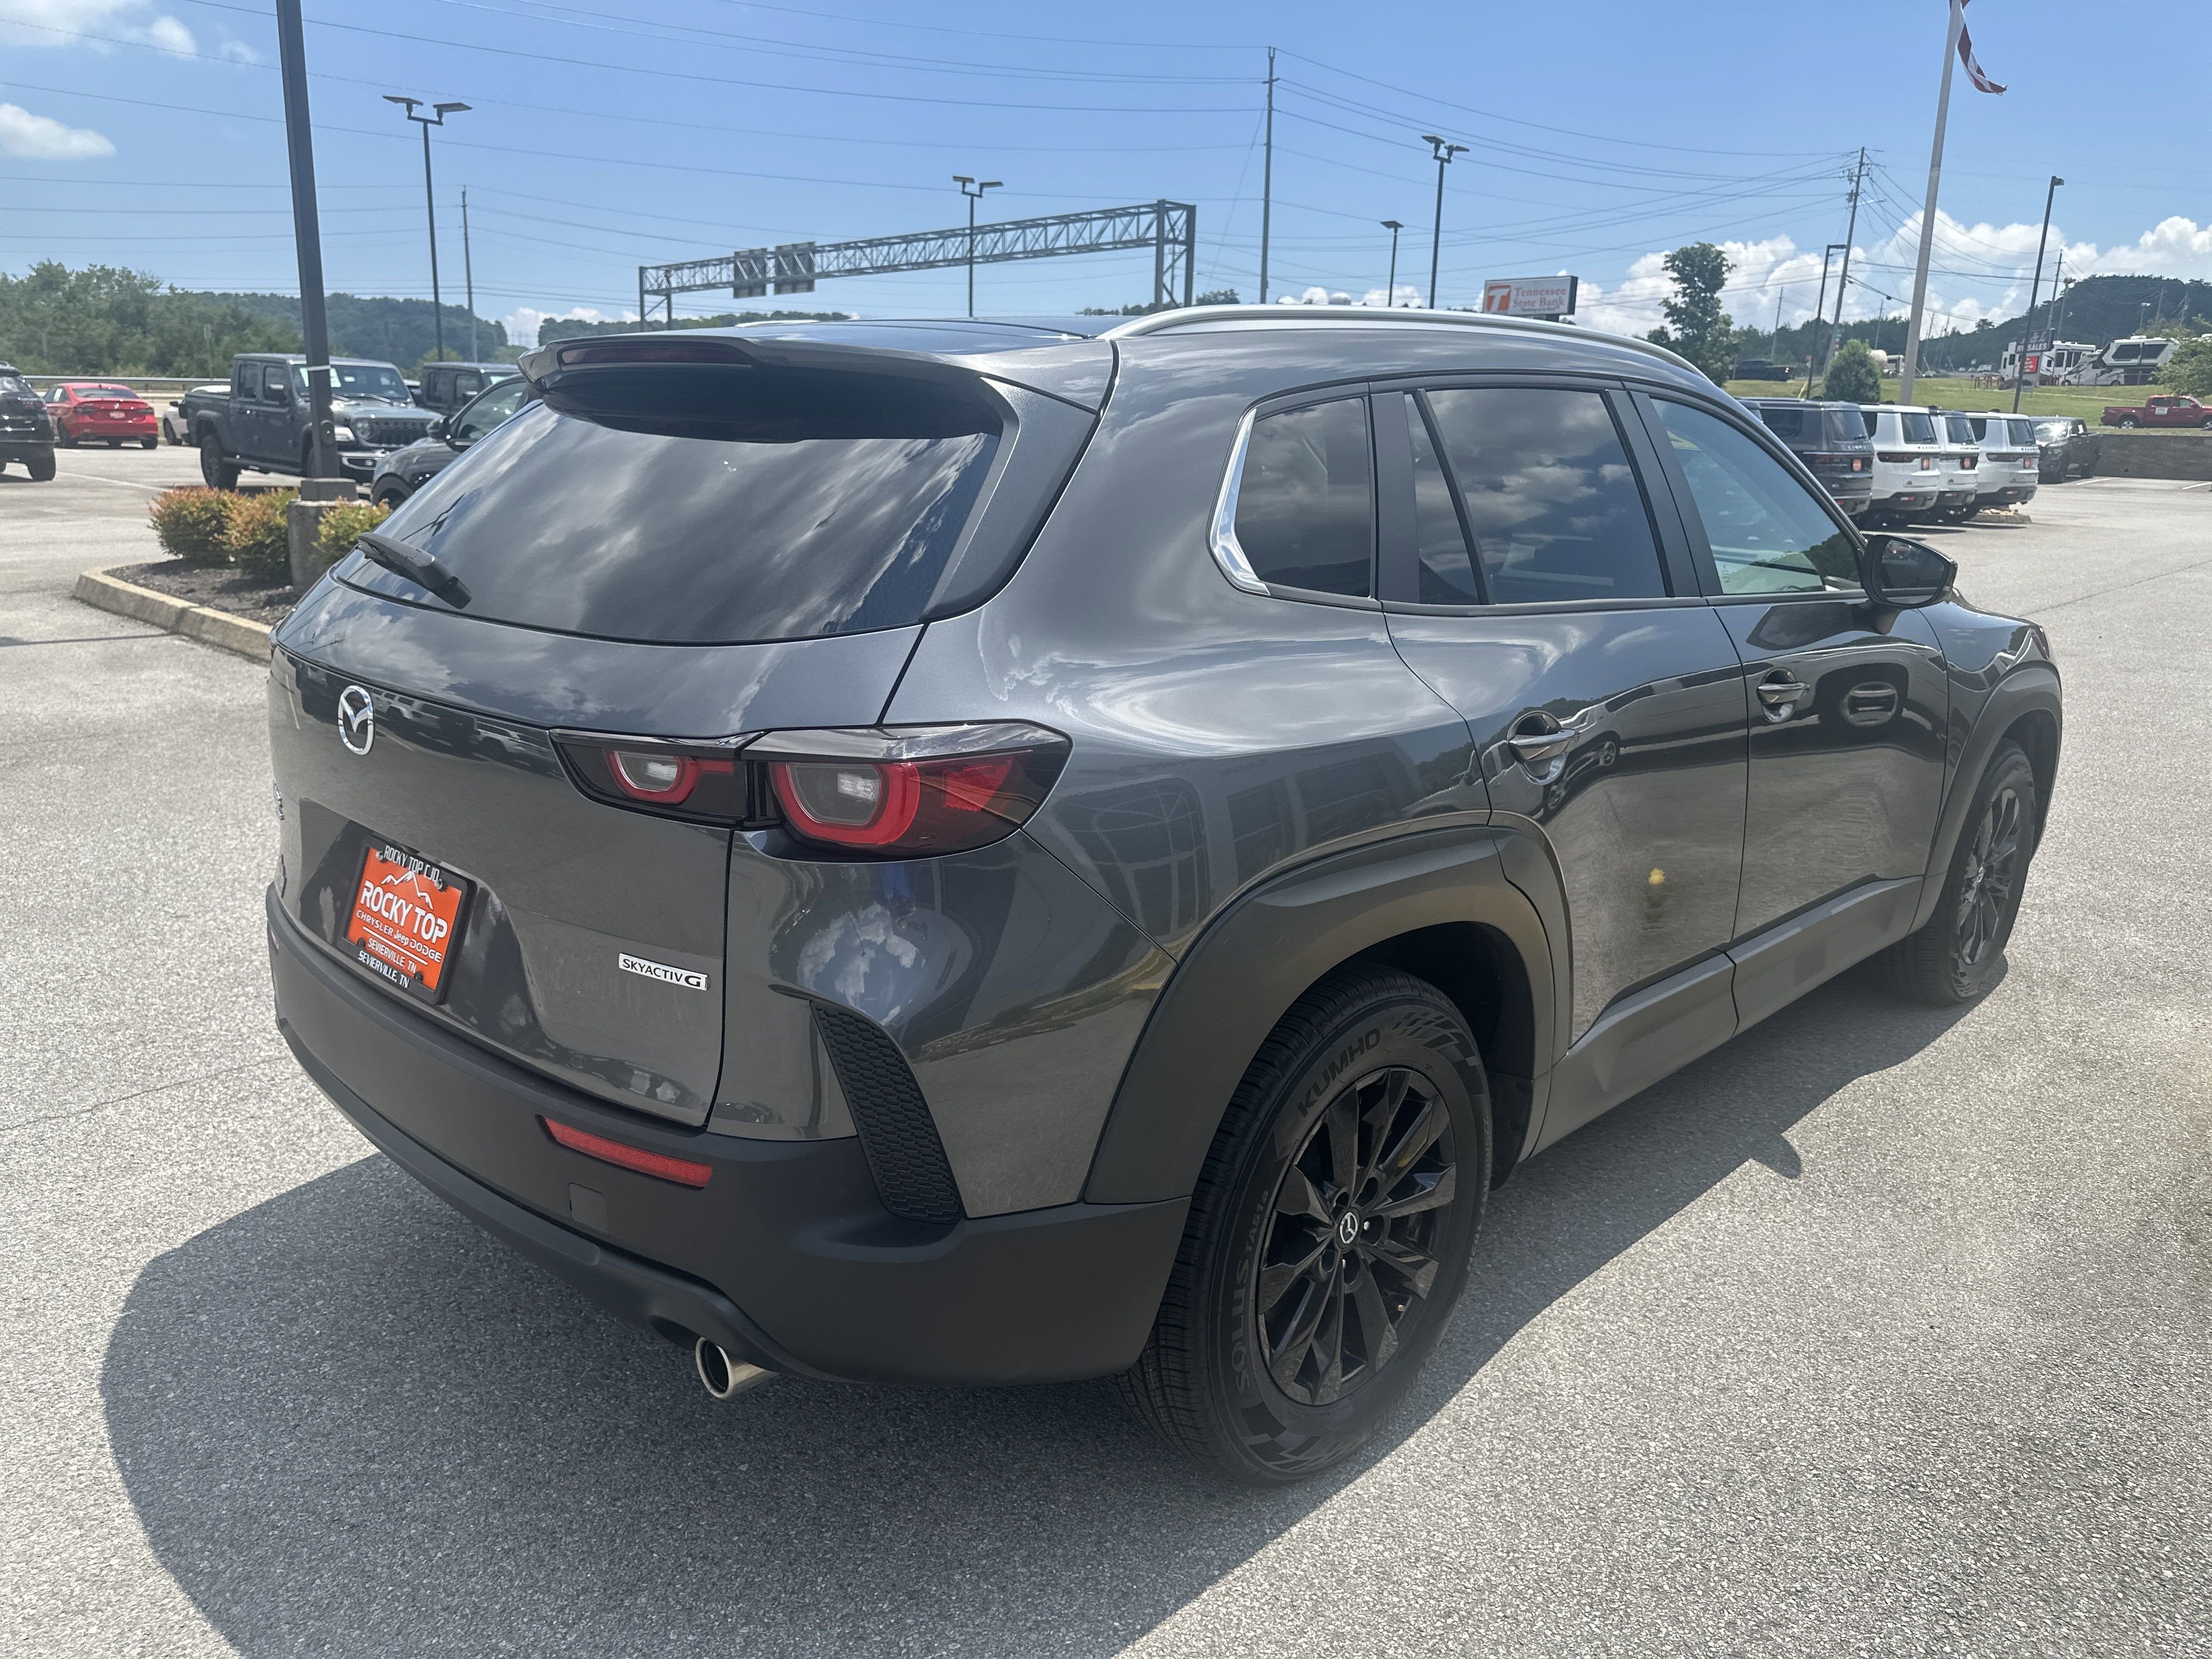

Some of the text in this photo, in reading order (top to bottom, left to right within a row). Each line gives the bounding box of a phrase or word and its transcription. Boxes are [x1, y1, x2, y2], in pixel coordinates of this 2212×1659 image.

[1513, 296, 1564, 308] State Bank
[1515, 287, 1566, 297] Tennessee
[2027, 342, 2047, 351] SALES
[385, 845, 407, 867] ROCKY
[409, 856, 423, 873] TOP
[360, 880, 448, 944] ROCKY TOP
[357, 909, 442, 963] CHRYSLER Jeep DODGE
[408, 960, 417, 974] TN
[399, 975, 410, 988] TN
[1297, 1028, 1381, 1118] KUMHO
[1231, 1260, 1250, 1394] SOLUS
